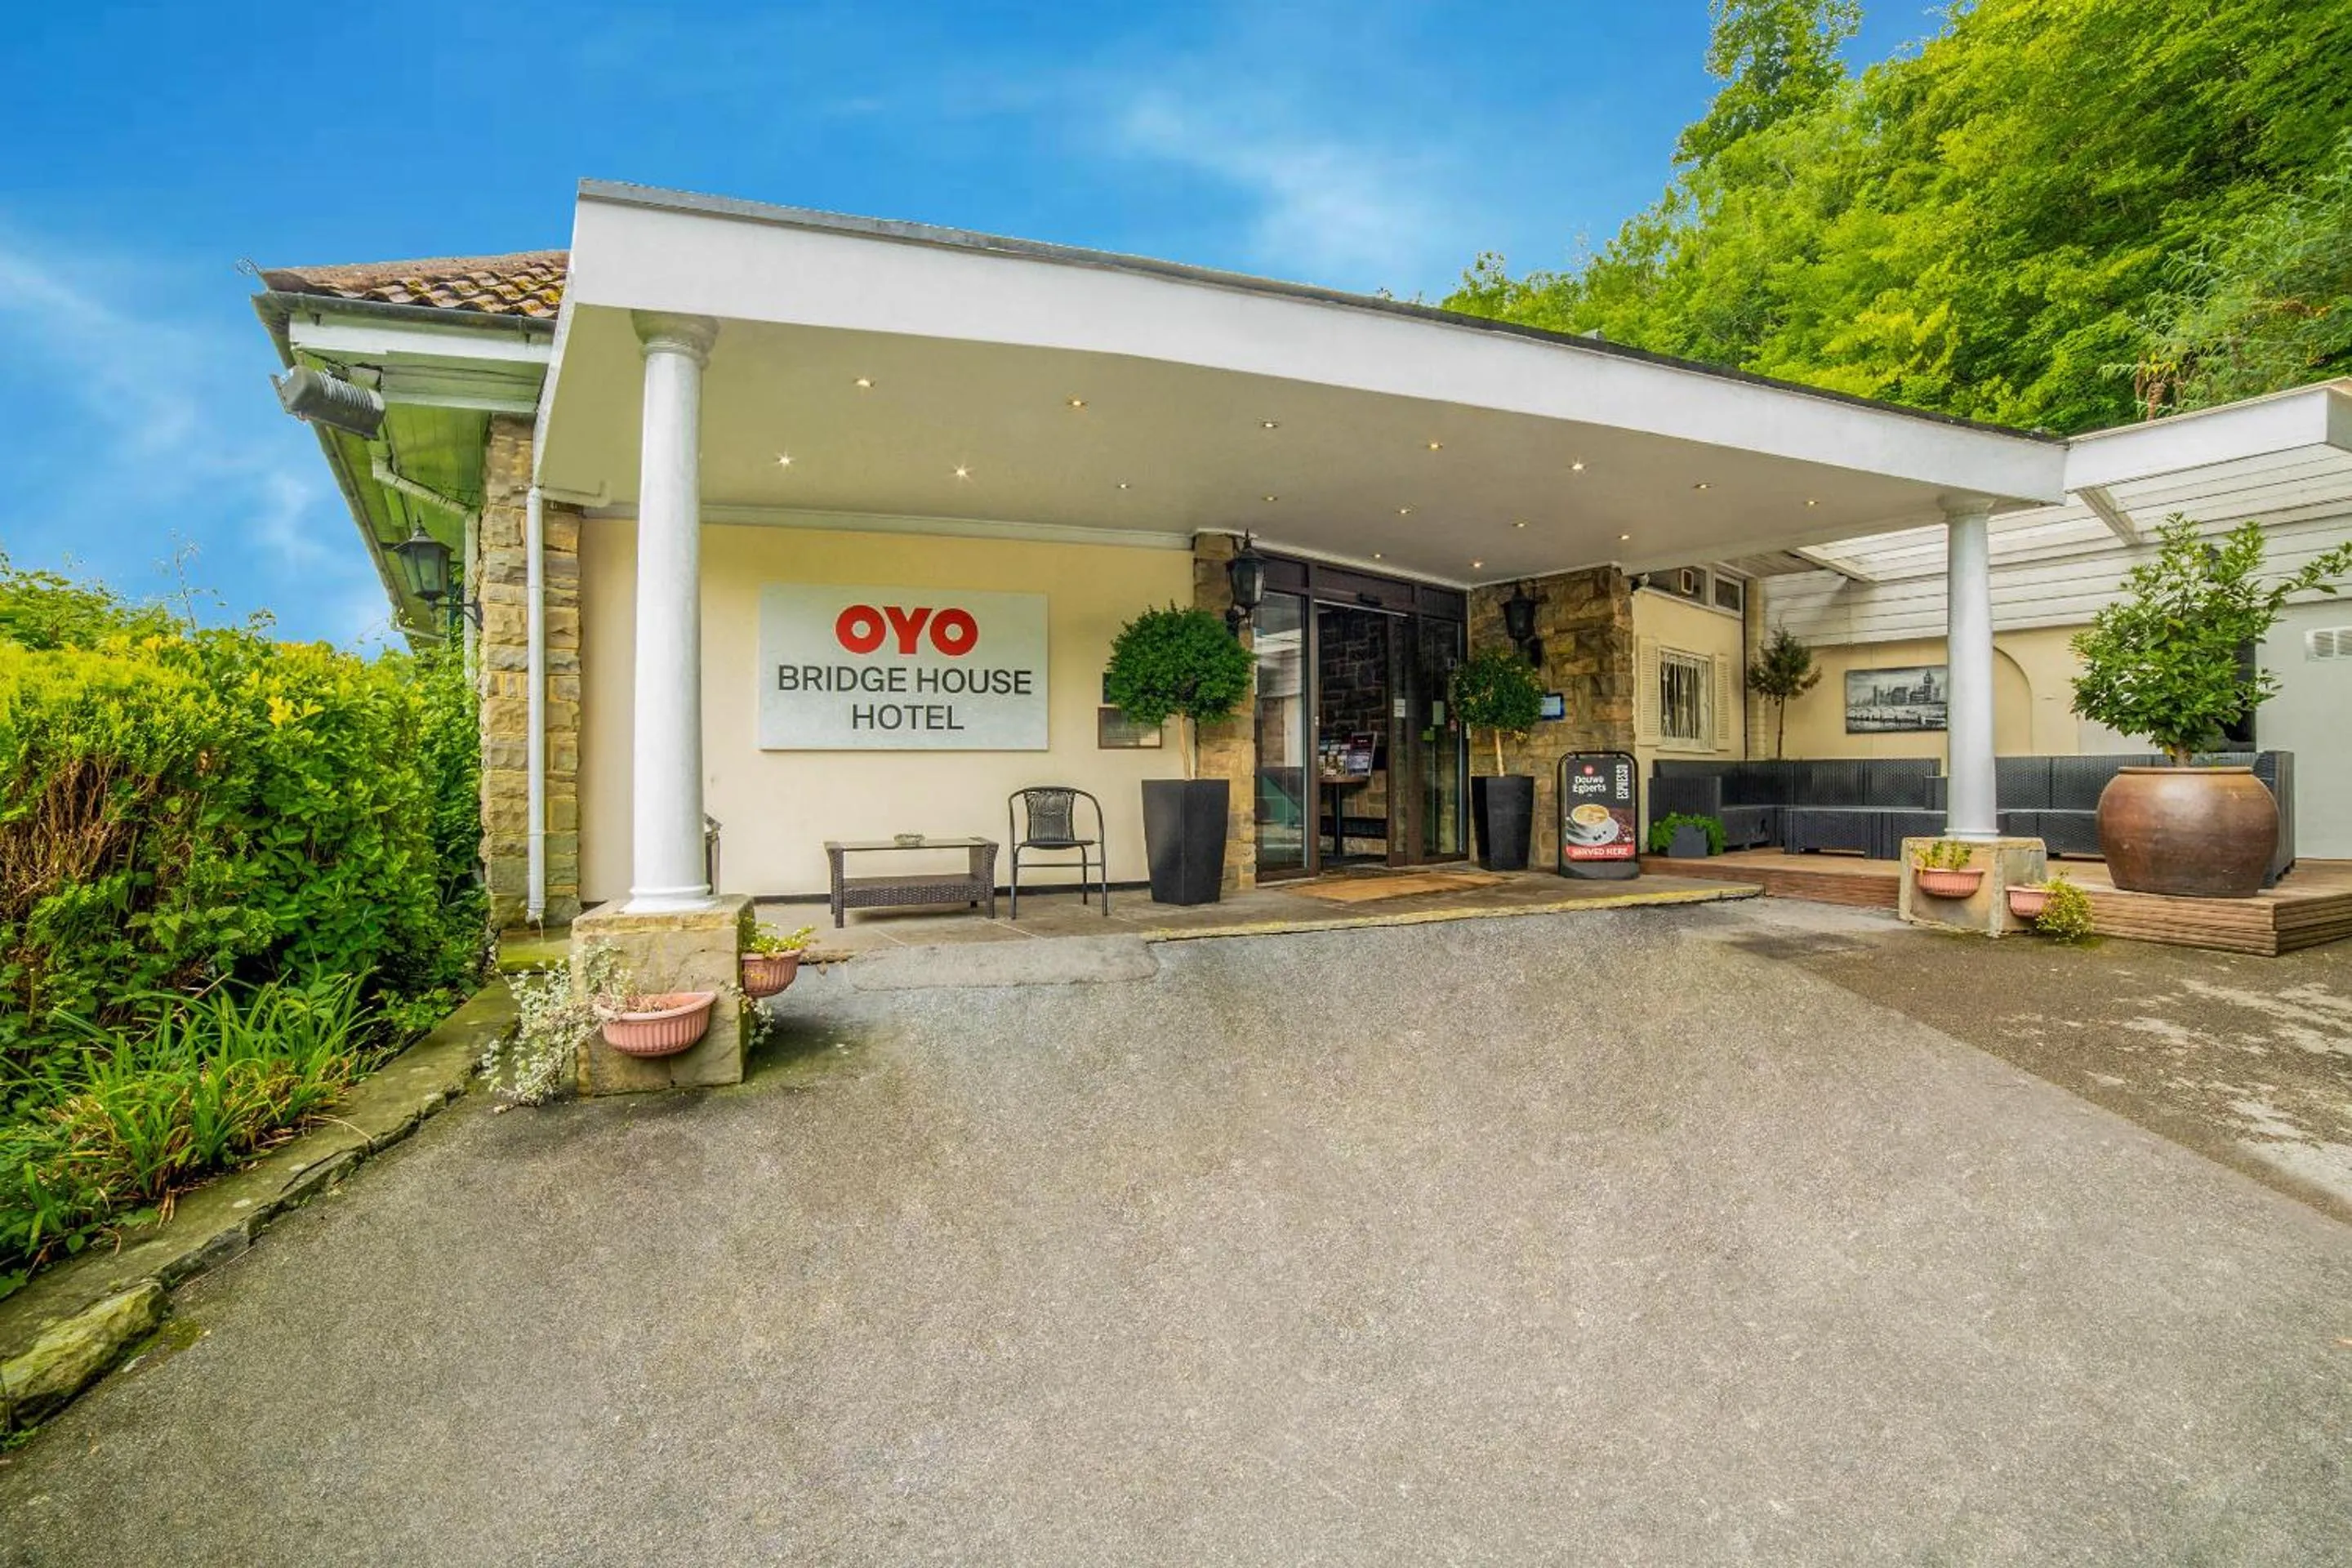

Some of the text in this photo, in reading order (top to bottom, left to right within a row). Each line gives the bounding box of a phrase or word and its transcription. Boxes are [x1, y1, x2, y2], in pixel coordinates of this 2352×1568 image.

[835, 604, 978, 656] OYO
[777, 665, 1032, 695] BRIDGE HOUSE
[852, 704, 964, 730] HOTEL
[1572, 783, 1606, 795] Egberts
[1575, 776, 1604, 784] Douwe
[1573, 847, 1628, 857] SERVED HERE
